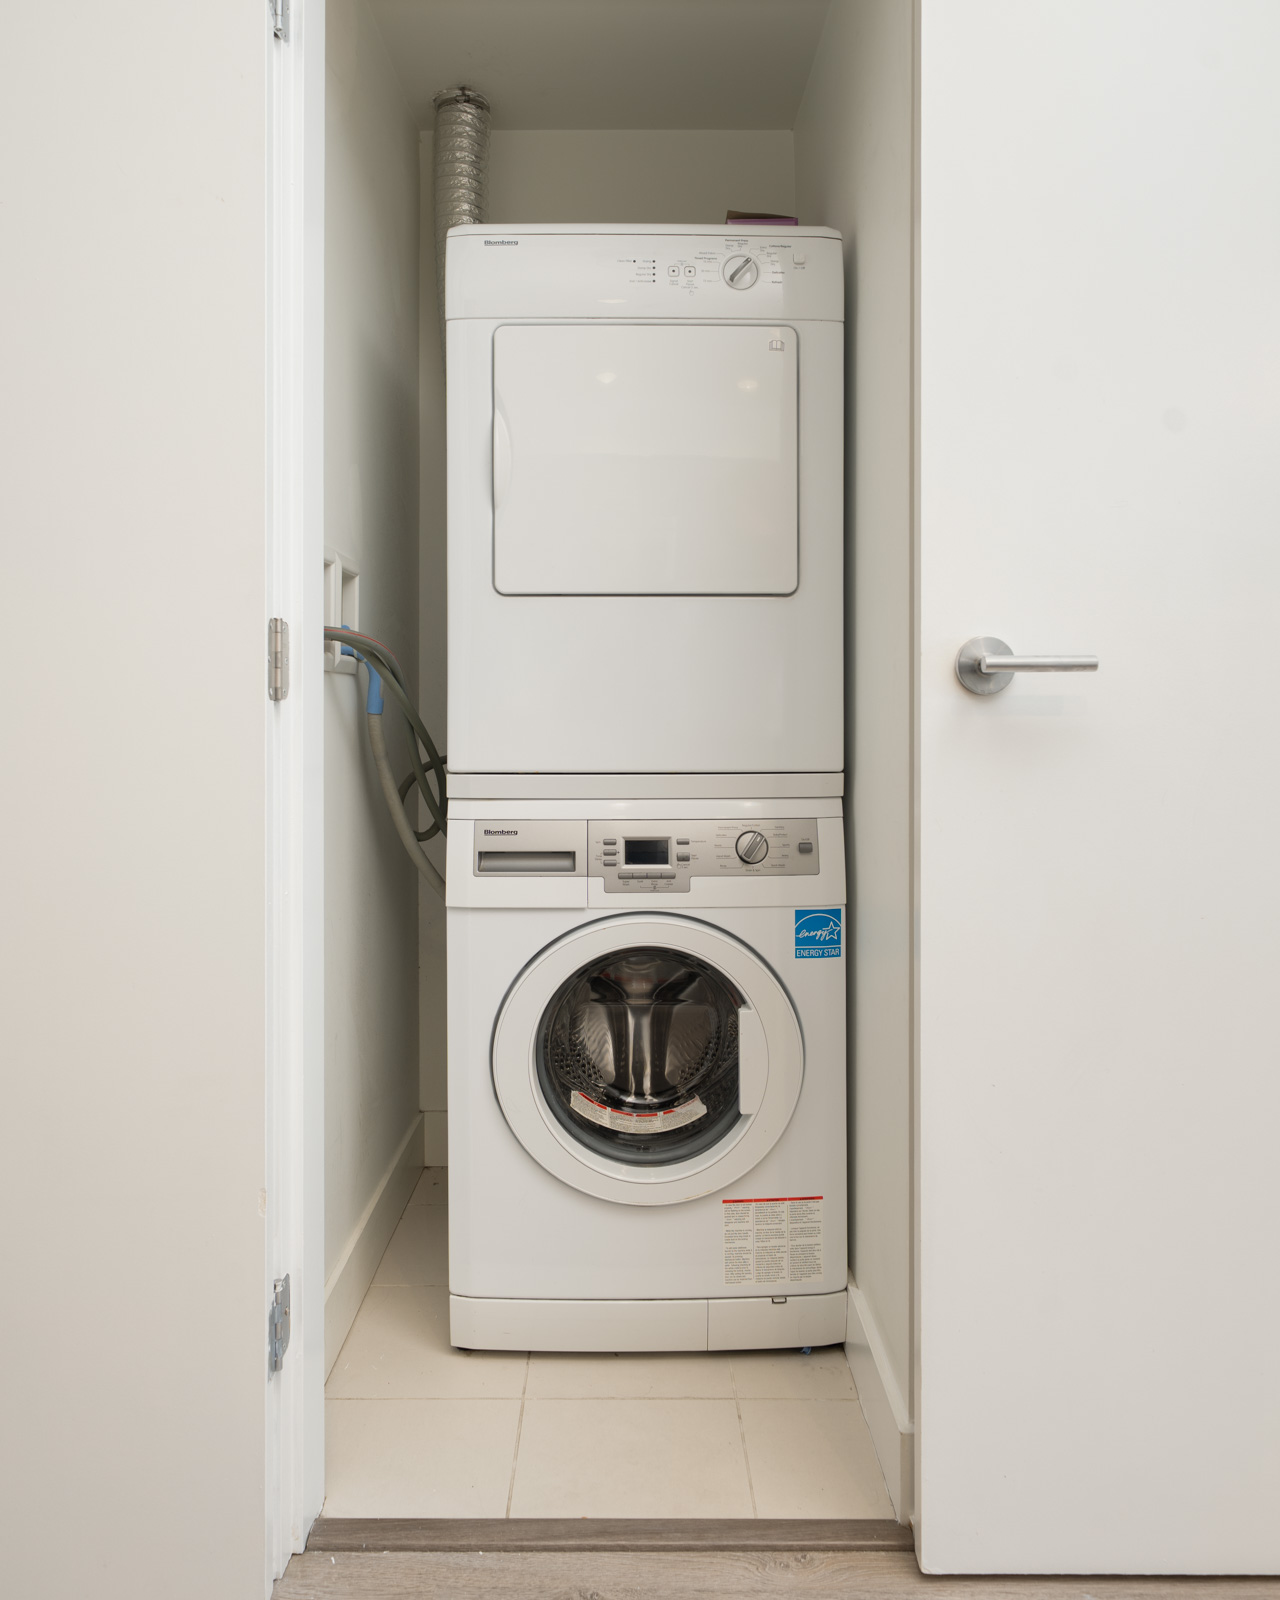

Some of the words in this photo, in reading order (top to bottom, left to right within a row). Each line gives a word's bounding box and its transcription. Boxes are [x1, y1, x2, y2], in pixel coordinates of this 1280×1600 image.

[484, 239, 518, 247] Blomberg
[796, 929, 833, 941] energy
[797, 949, 823, 957] ENERGY
[824, 948, 840, 957] STAR
